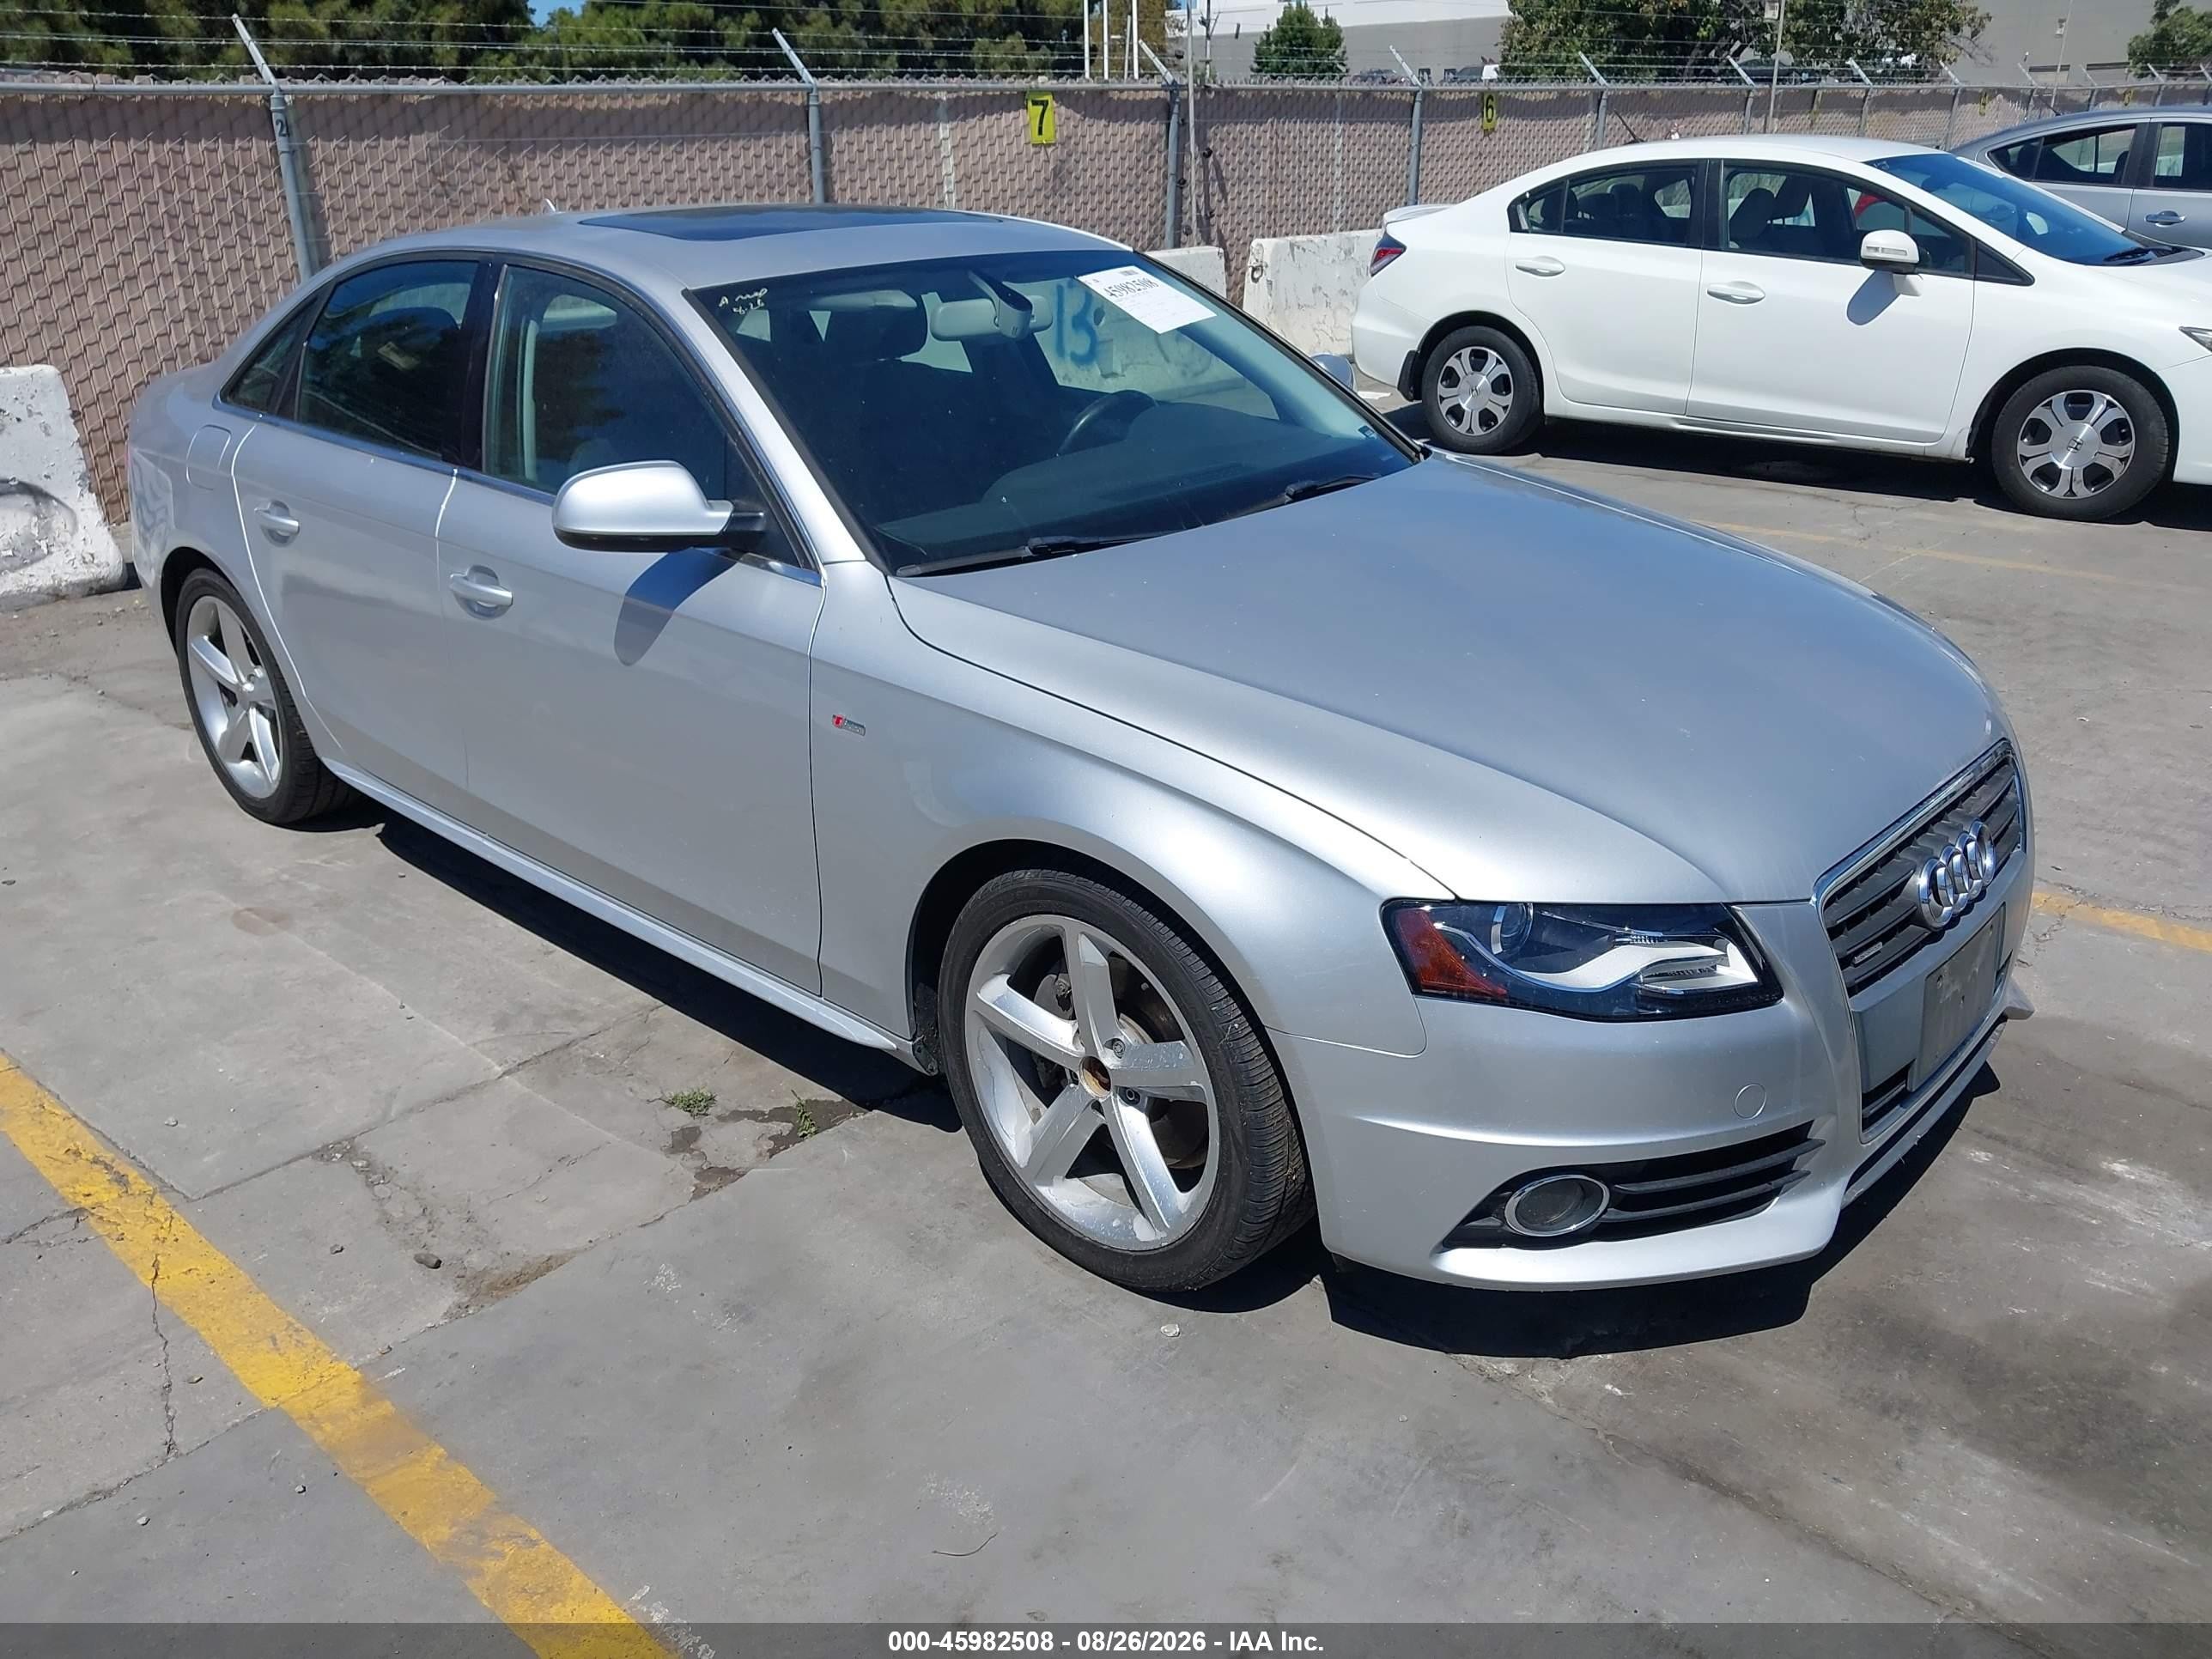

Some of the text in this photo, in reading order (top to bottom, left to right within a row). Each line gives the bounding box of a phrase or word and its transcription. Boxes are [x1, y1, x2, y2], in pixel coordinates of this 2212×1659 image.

[1031, 99, 1049, 136] 7
[1486, 94, 1494, 123] 6
[1103, 277, 1159, 298] 45982508
